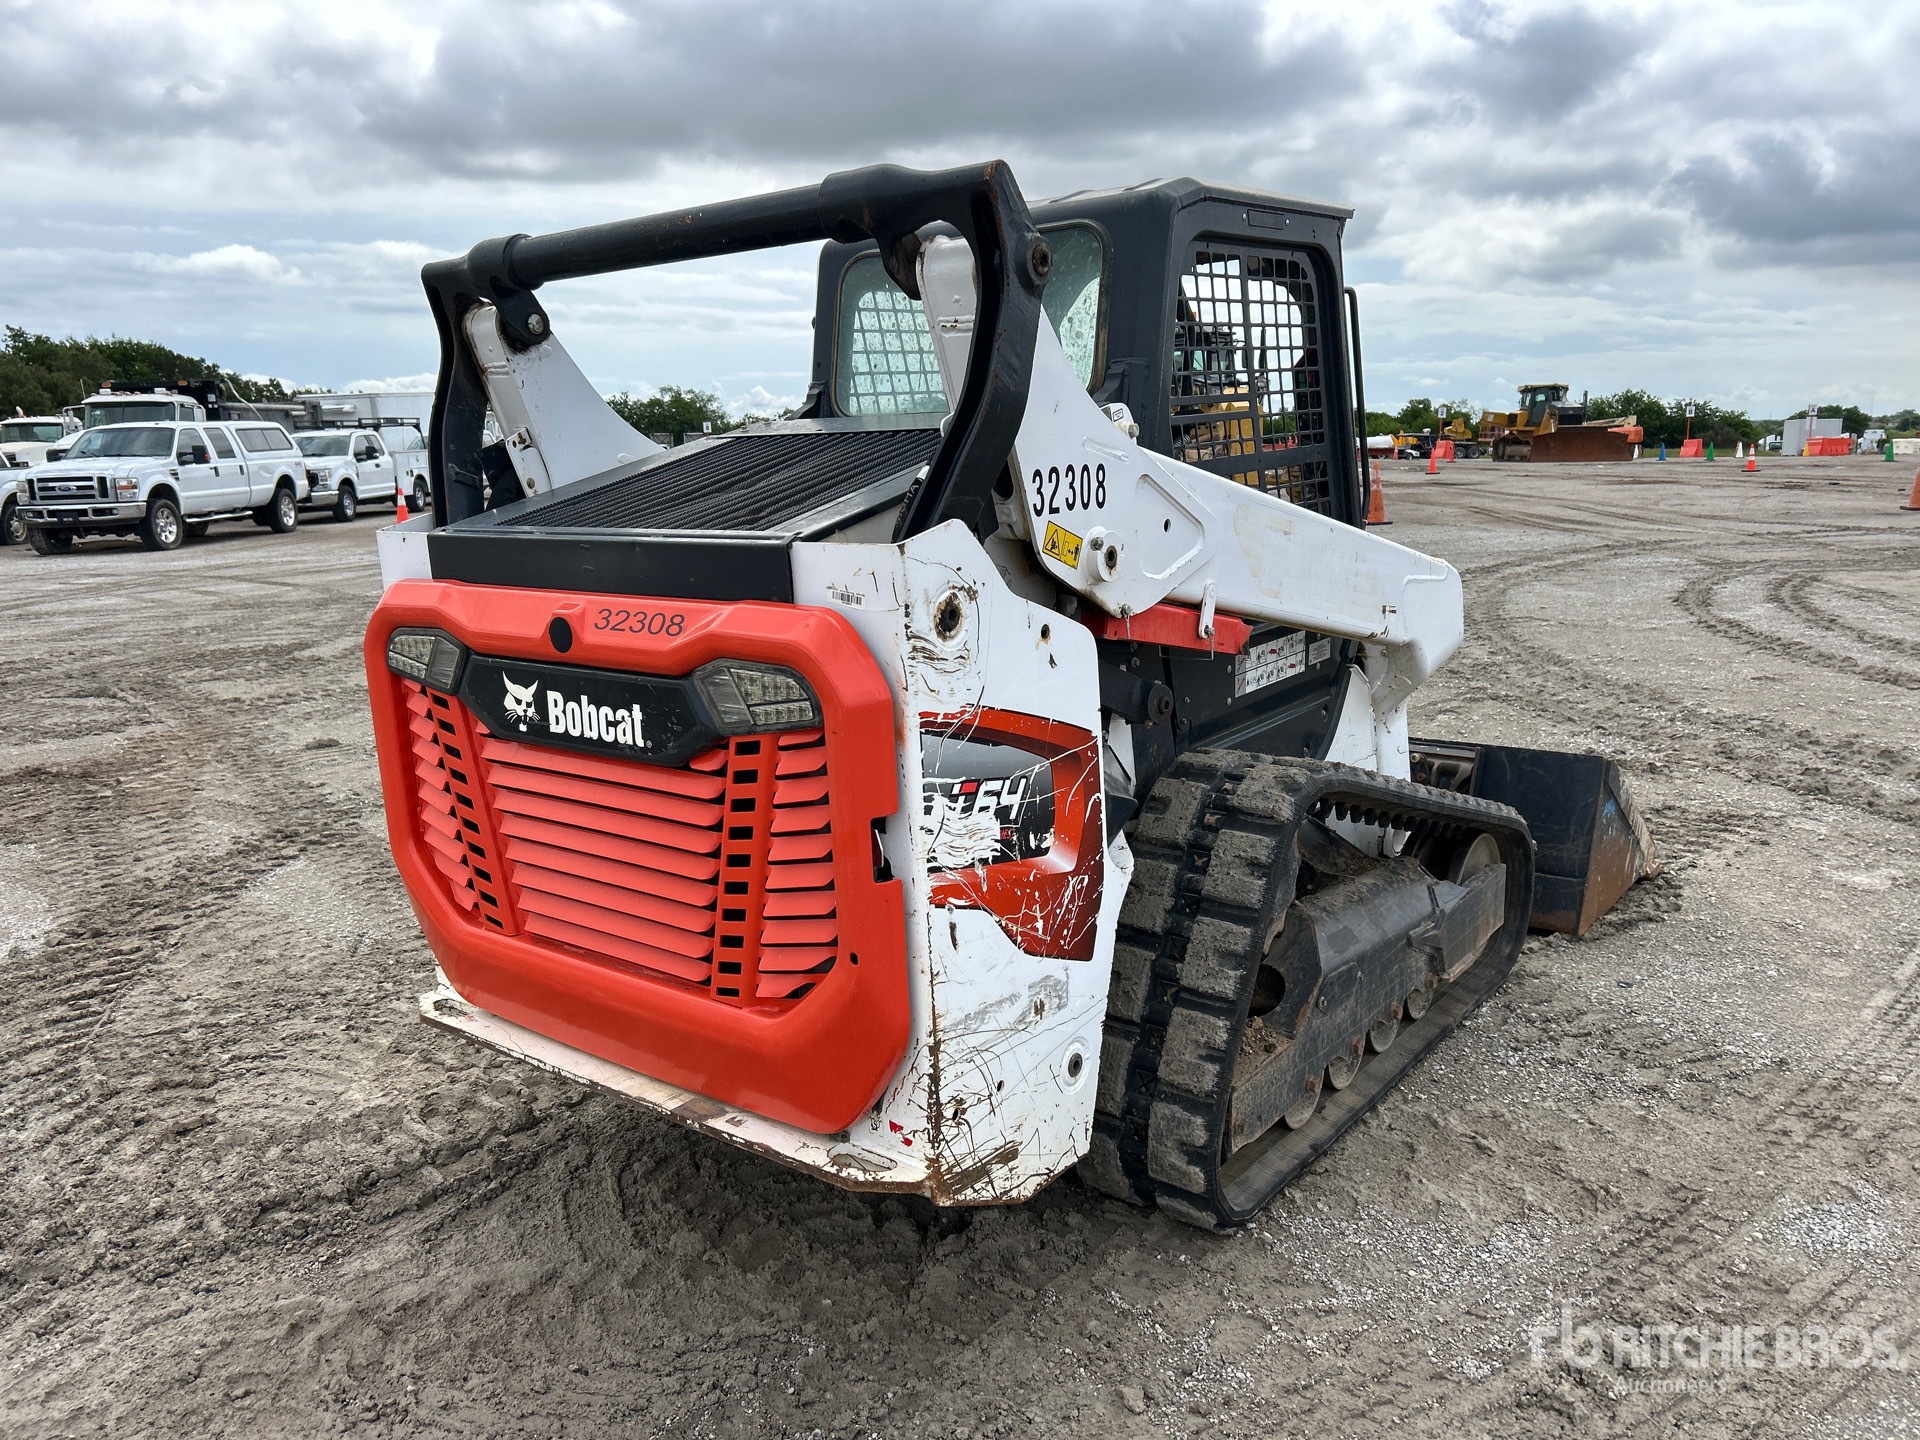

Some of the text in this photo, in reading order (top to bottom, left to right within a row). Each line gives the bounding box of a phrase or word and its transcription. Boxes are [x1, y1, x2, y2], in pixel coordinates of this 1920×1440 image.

[1032, 463, 1106, 517] 32308
[594, 608, 685, 637] 32308
[546, 690, 645, 748] Bobcat
